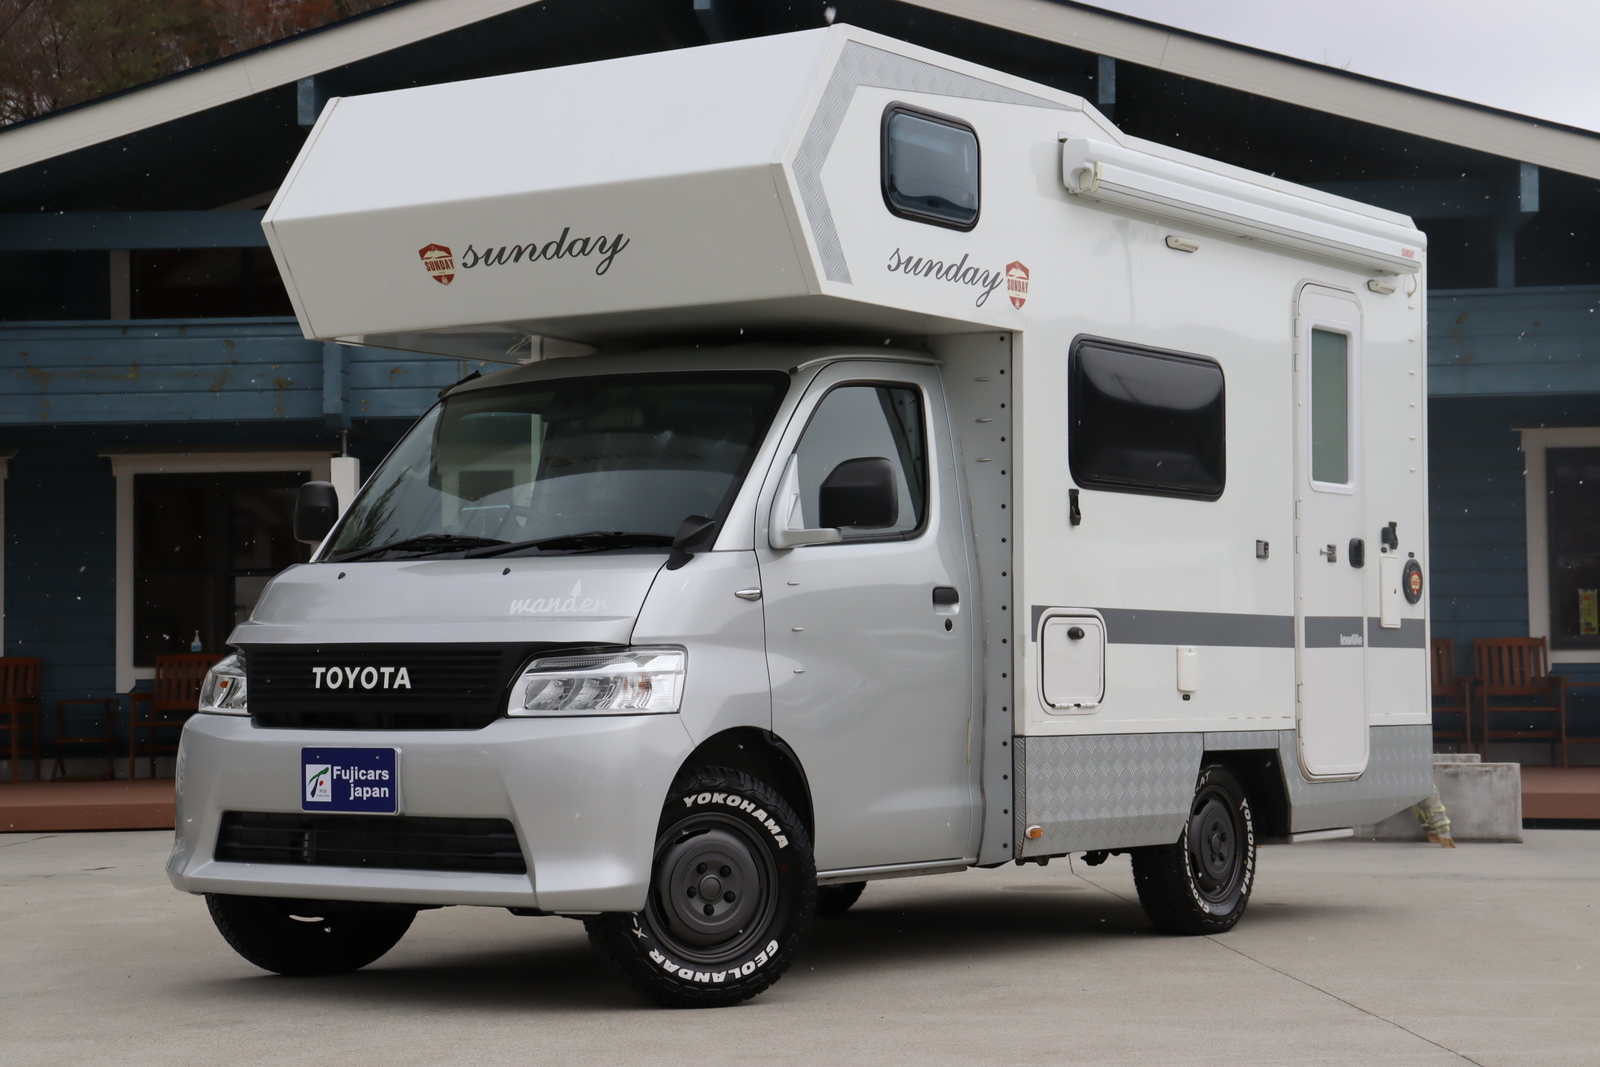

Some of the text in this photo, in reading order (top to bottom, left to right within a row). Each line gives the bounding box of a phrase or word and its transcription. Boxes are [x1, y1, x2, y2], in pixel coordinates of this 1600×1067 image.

[424, 258, 455, 272] SUNDAY
[461, 226, 630, 276] sunday
[887, 247, 1004, 308] sunday
[1006, 278, 1029, 294] SUNDAY
[312, 666, 412, 690] TOYOTA
[332, 765, 390, 783] Fujicars
[349, 783, 390, 801] japan
[683, 792, 789, 849] YOKOHAMA
[1239, 798, 1254, 895] YOKOHAMA
[648, 939, 779, 983] GEOLANDAR
